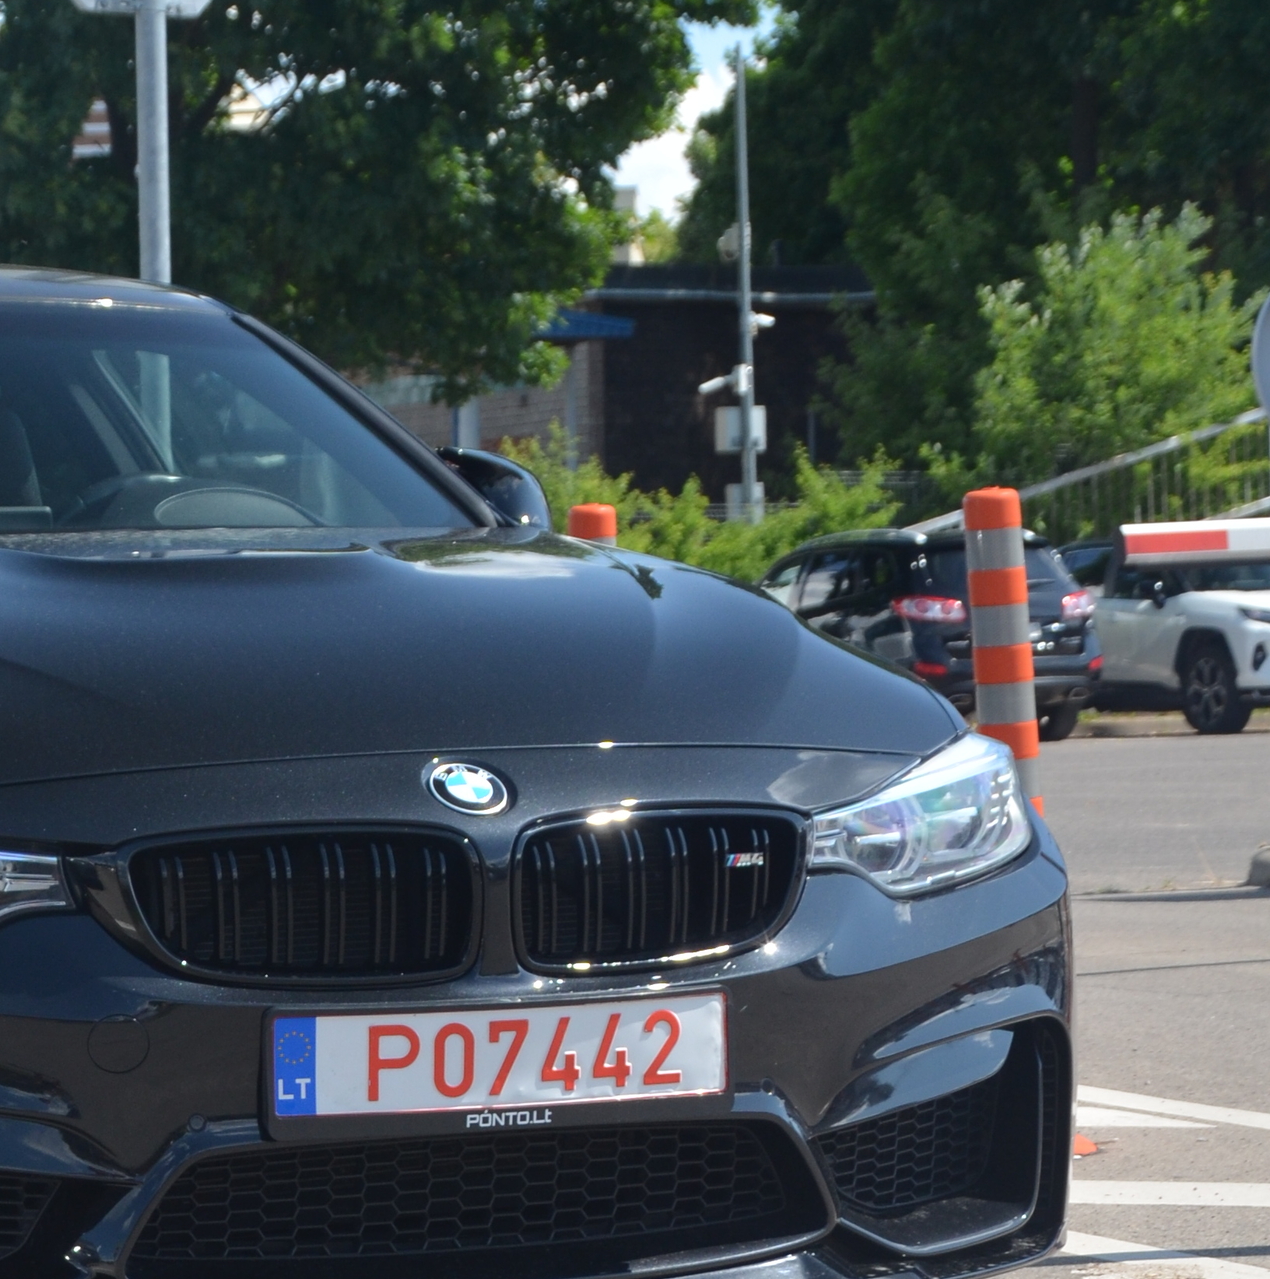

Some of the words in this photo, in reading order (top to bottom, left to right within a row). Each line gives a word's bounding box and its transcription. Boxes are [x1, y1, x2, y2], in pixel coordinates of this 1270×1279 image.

[434, 765, 493, 781] BMW
[278, 1077, 311, 1100] LT
[368, 1009, 682, 1101] P07442
